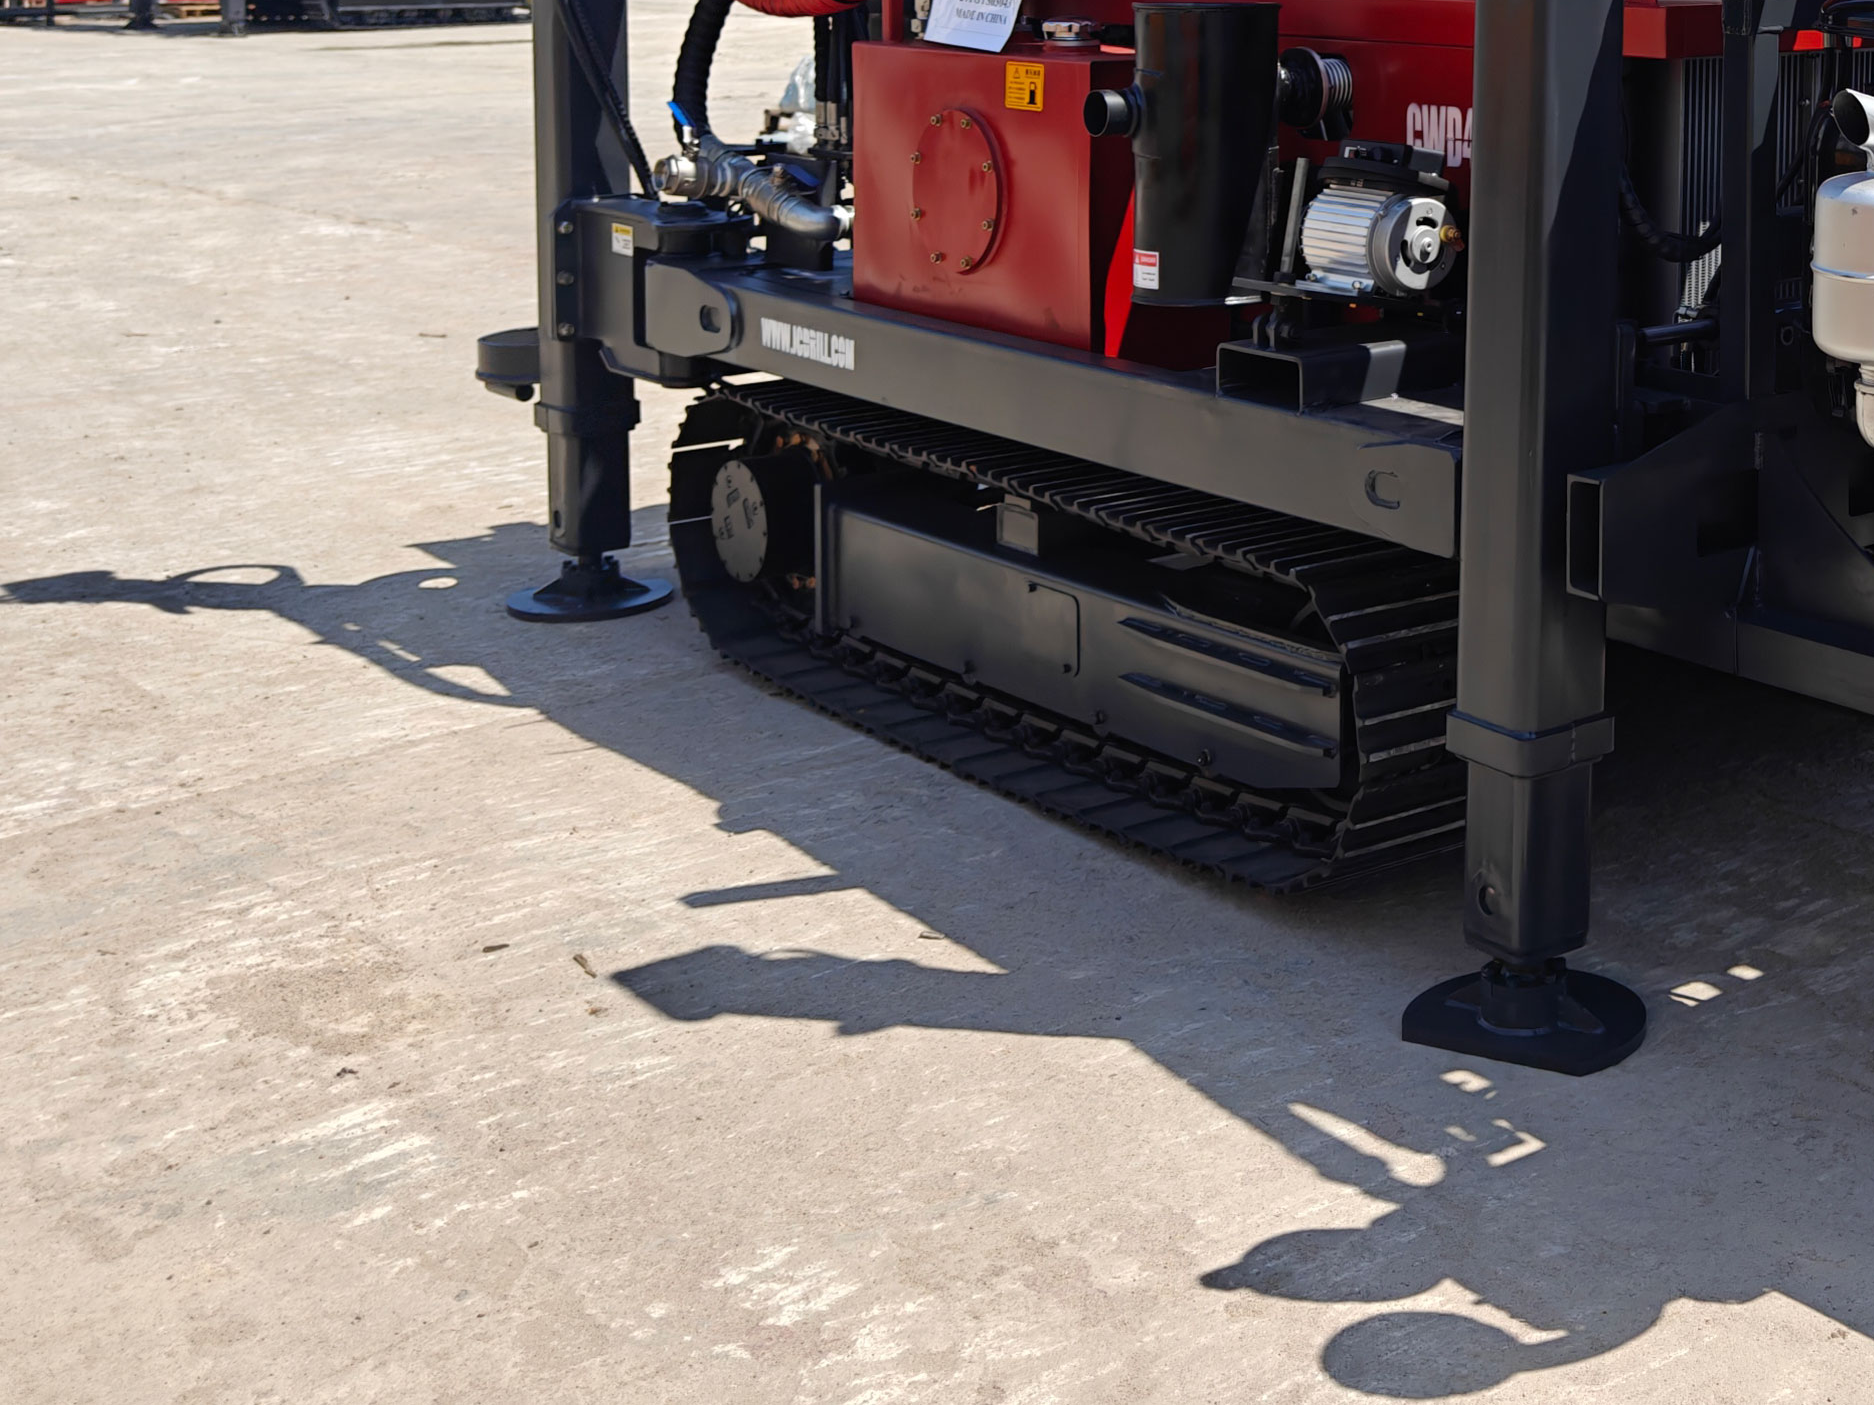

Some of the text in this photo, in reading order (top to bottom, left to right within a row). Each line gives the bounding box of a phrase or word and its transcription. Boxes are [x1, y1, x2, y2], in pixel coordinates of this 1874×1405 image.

[956, 7, 1008, 25] MADE IN CHINA
[761, 317, 855, 371] WWW.JCDRILL.COM
